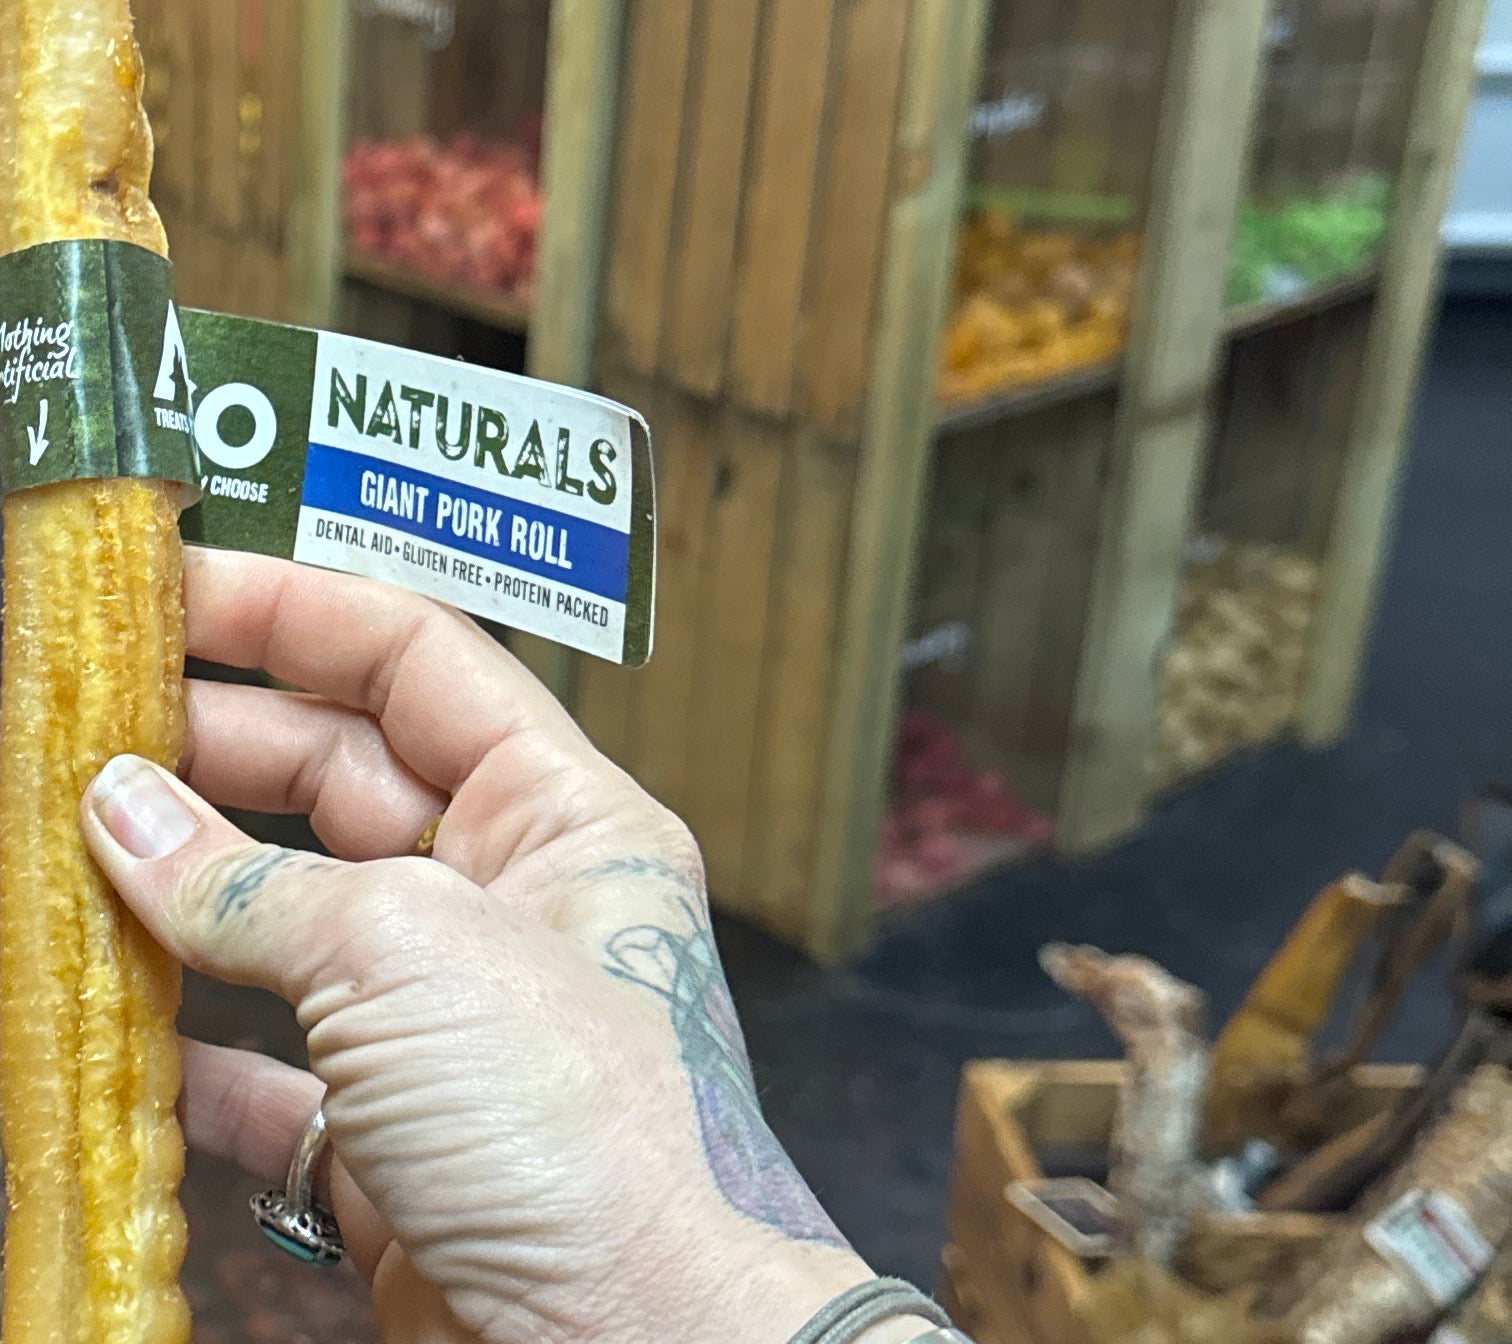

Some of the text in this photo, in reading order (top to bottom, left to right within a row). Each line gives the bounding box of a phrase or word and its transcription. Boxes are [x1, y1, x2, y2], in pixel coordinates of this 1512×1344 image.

[328, 367, 617, 505] NATURALS
[210, 475, 269, 503] CHOOSE
[360, 470, 572, 569] GIANT PORK ROLL
[316, 518, 609, 628] DENTAL AID GLUTEN FREE PROTEIN PACKED
